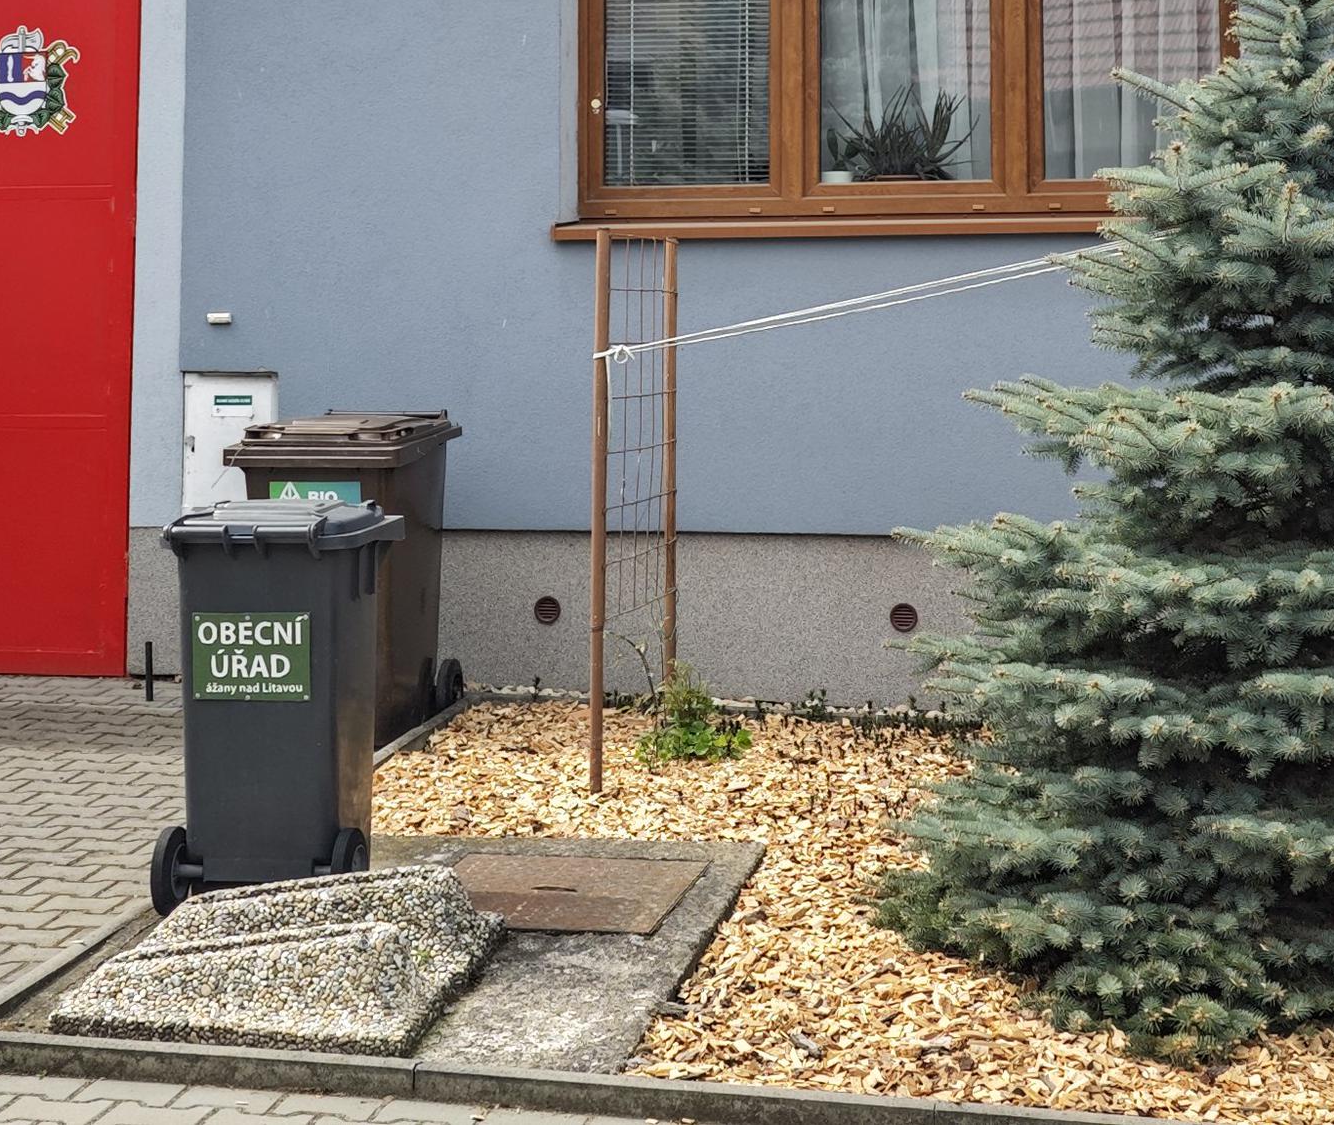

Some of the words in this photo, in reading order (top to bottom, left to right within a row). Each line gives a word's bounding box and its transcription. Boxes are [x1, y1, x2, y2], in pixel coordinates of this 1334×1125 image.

[197, 615, 304, 645] OBECNÍ
[210, 648, 291, 678] ÚŘAD
[239, 682, 259, 693] nad
[262, 682, 303, 693] Litavou
